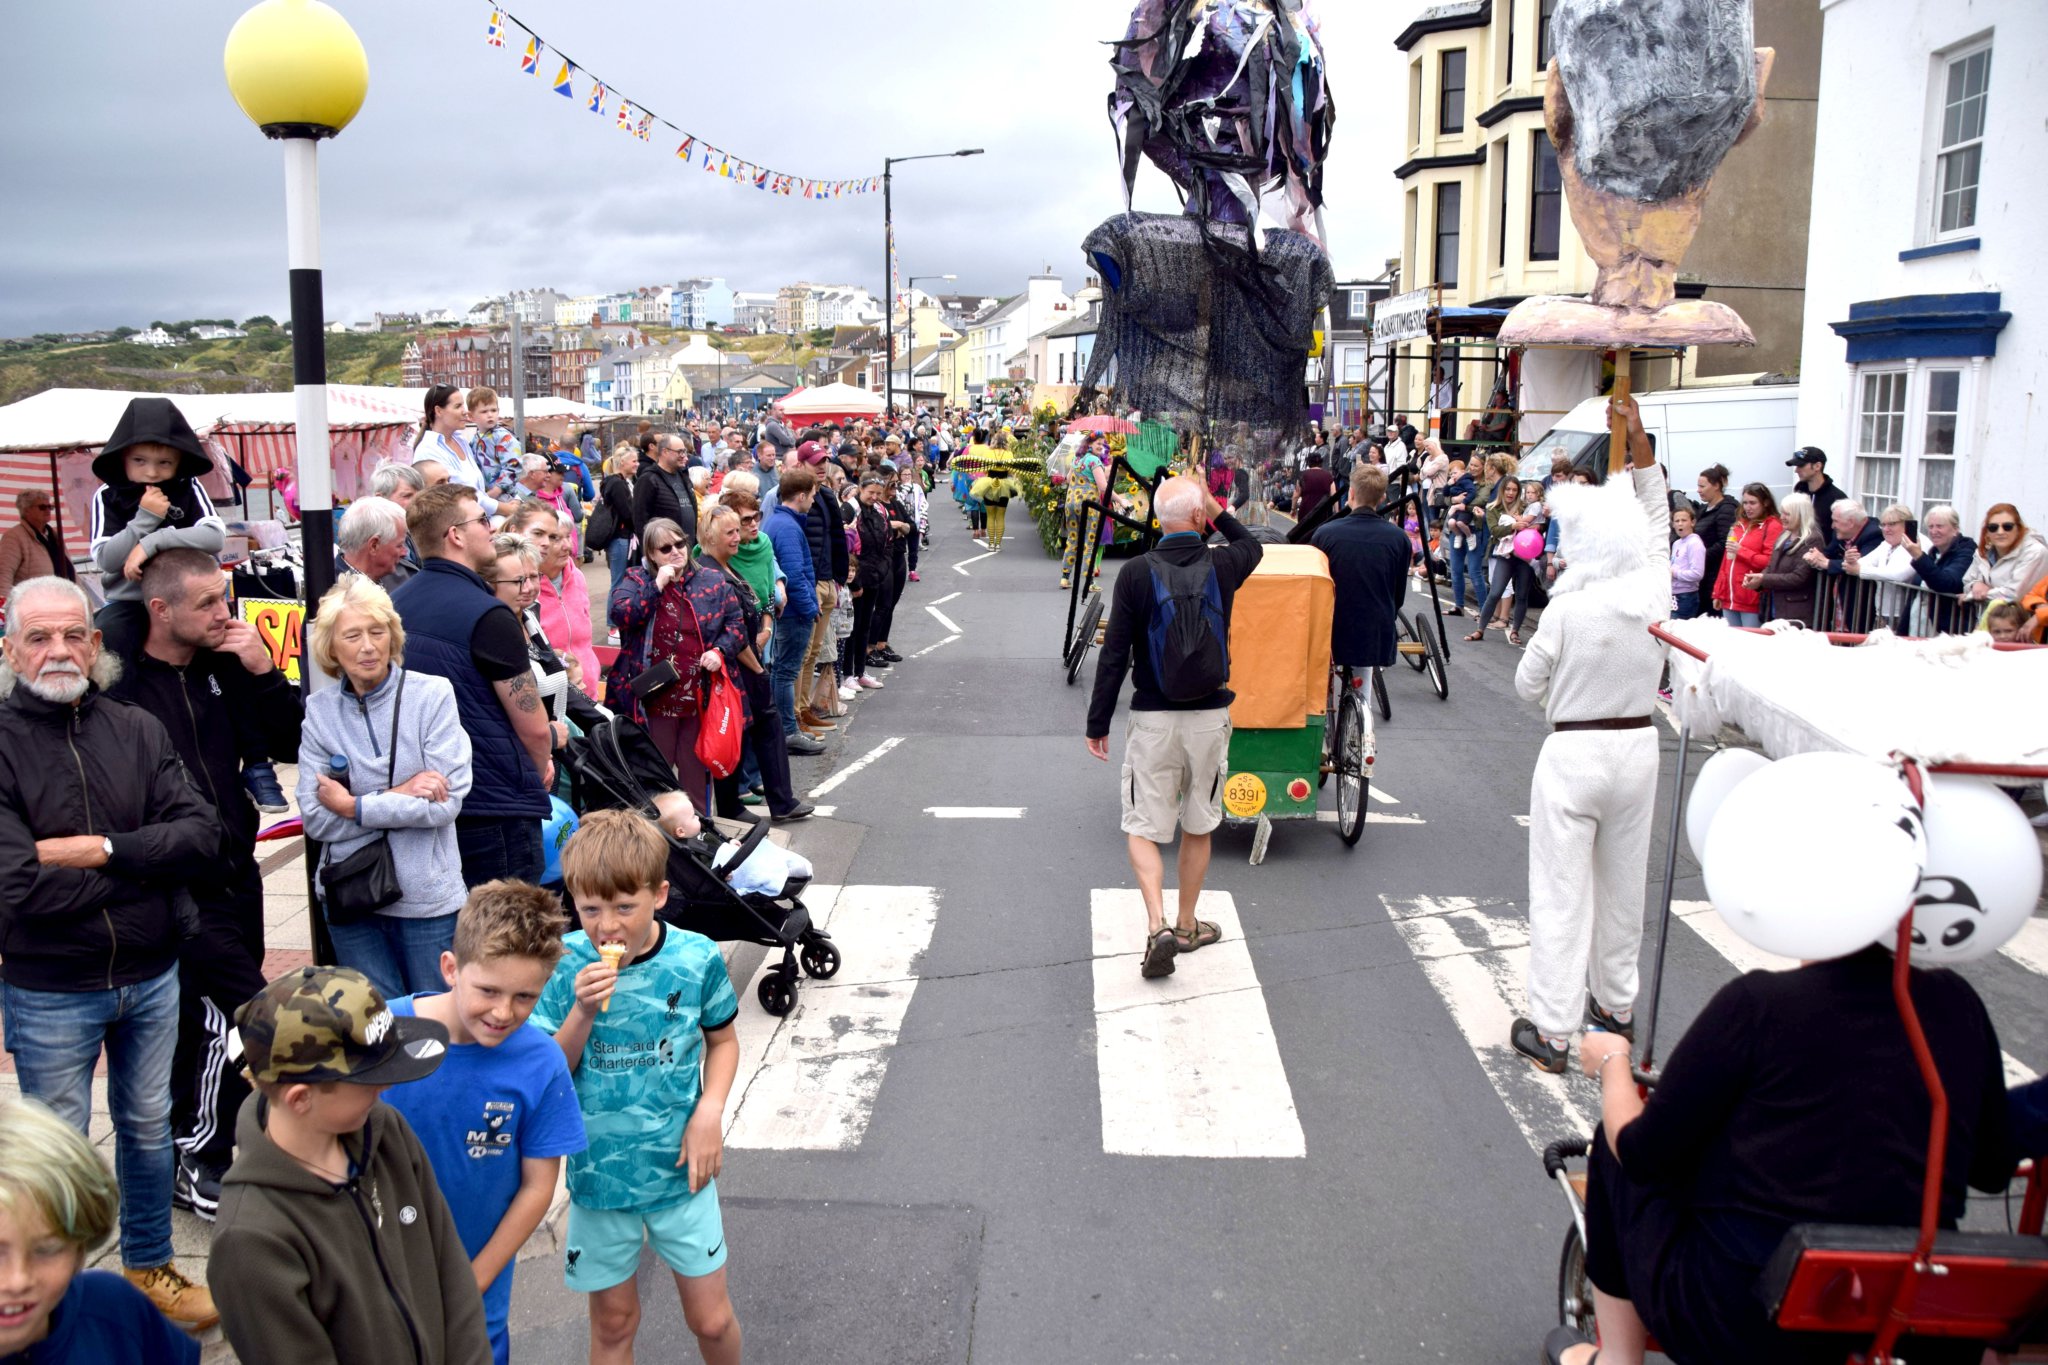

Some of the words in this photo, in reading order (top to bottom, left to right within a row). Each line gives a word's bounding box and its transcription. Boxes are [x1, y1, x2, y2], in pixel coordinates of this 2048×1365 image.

[256, 609, 302, 671] SA
[1229, 787, 1259, 802] 8391
[593, 1040, 655, 1054] Staard
[589, 1055, 656, 1070] Chartered
